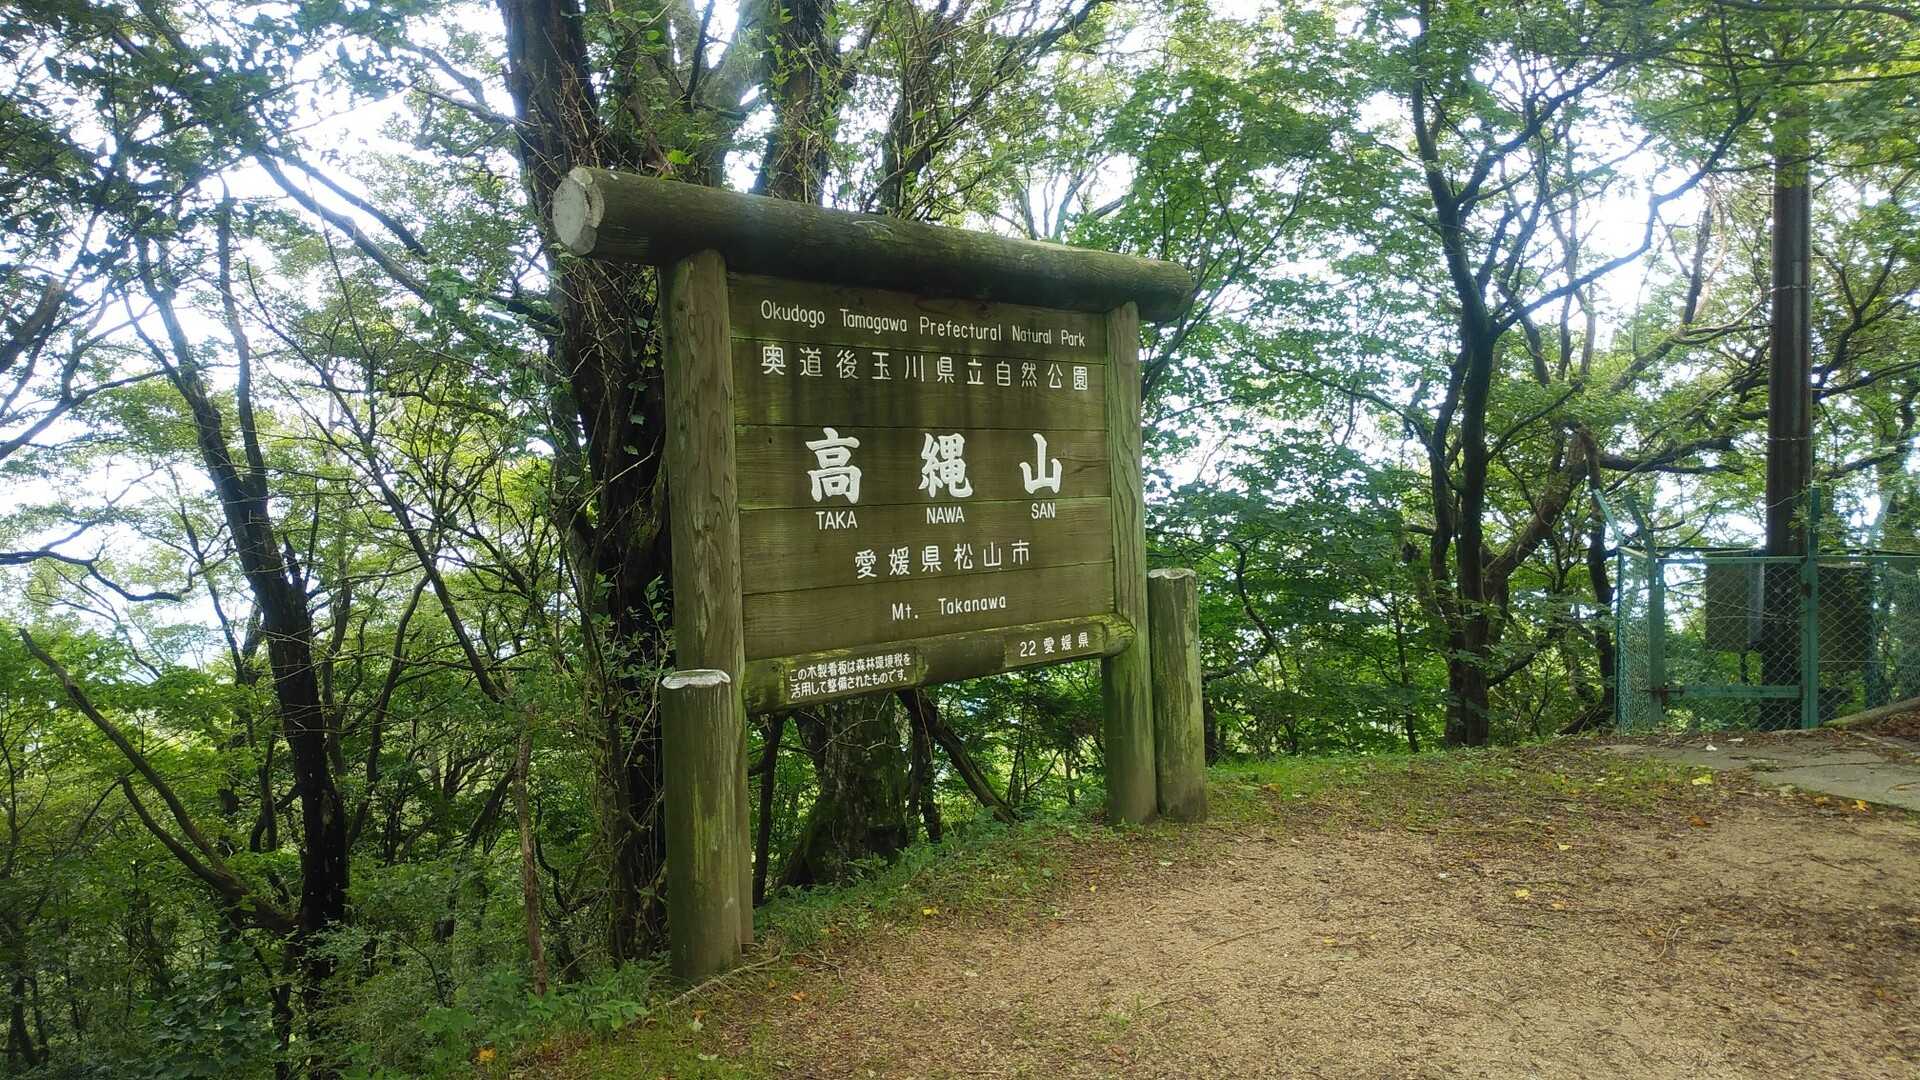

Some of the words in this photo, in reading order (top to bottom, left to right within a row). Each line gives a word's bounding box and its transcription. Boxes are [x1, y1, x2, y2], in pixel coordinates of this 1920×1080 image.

[761, 300, 825, 328] Okudogo
[839, 308, 908, 334] Tamagawa
[919, 316, 1001, 341] Prefectural
[1012, 325, 1052, 345] Natural
[1061, 329, 1085, 347] Park
[761, 344, 1088, 391] 奥道後玉川県立自然公園
[805, 427, 1063, 504] 高縄山
[815, 510, 858, 530] TAKA
[926, 506, 965, 524] NAWA
[1031, 502, 1056, 519] SAN
[854, 539, 1030, 579] 愛媛県松山市
[891, 602, 919, 621] Mt.
[938, 595, 1006, 616] Takanawa
[789, 652, 911, 682] この木製看板は森林環境税を
